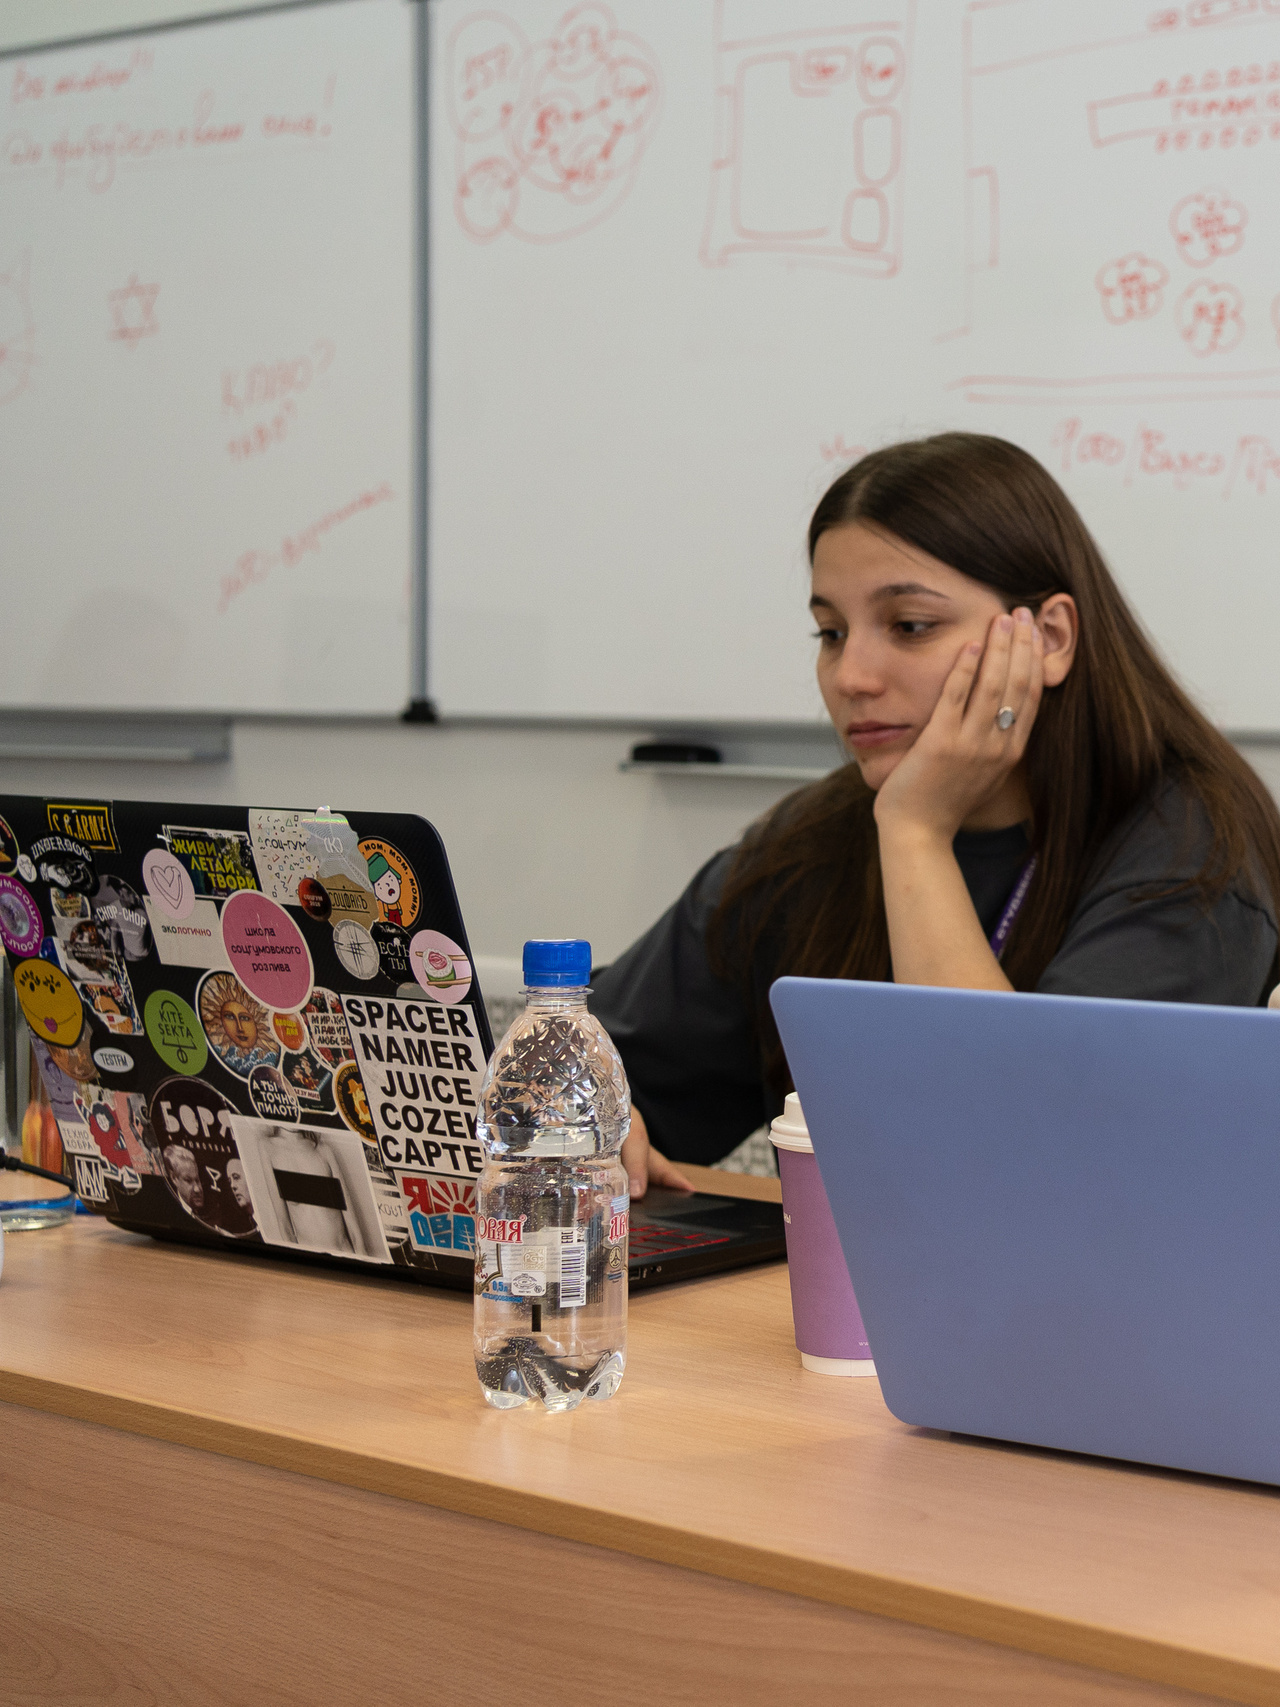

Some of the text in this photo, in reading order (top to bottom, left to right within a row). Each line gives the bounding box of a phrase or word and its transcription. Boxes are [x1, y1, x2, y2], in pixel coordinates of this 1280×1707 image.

[31, 836, 92, 862] UNDERDOG
[171, 837, 223, 859] ЖИВИ,
[190, 856, 240, 875] ЛЕТАЙ,
[207, 872, 258, 890] ТВОРИ
[378, 941, 410, 958] ЕСТЬ
[252, 962, 291, 973] розлива
[388, 957, 407, 971] ТЫ
[159, 1008, 185, 1025] KITE
[346, 998, 474, 1038] SPACER
[158, 1023, 194, 1039] SEKTA
[359, 1033, 478, 1072] NAMER
[252, 1078, 278, 1093] А ТЫ
[380, 1069, 476, 1107] JUICE
[261, 1091, 297, 1106] ТОЧНО
[257, 1102, 298, 1118] ПИЛОТ?
[159, 1101, 232, 1138] БОРЯ
[62, 1127, 90, 1141] ТЕХНО
[381, 1135, 486, 1174] CAPTE
